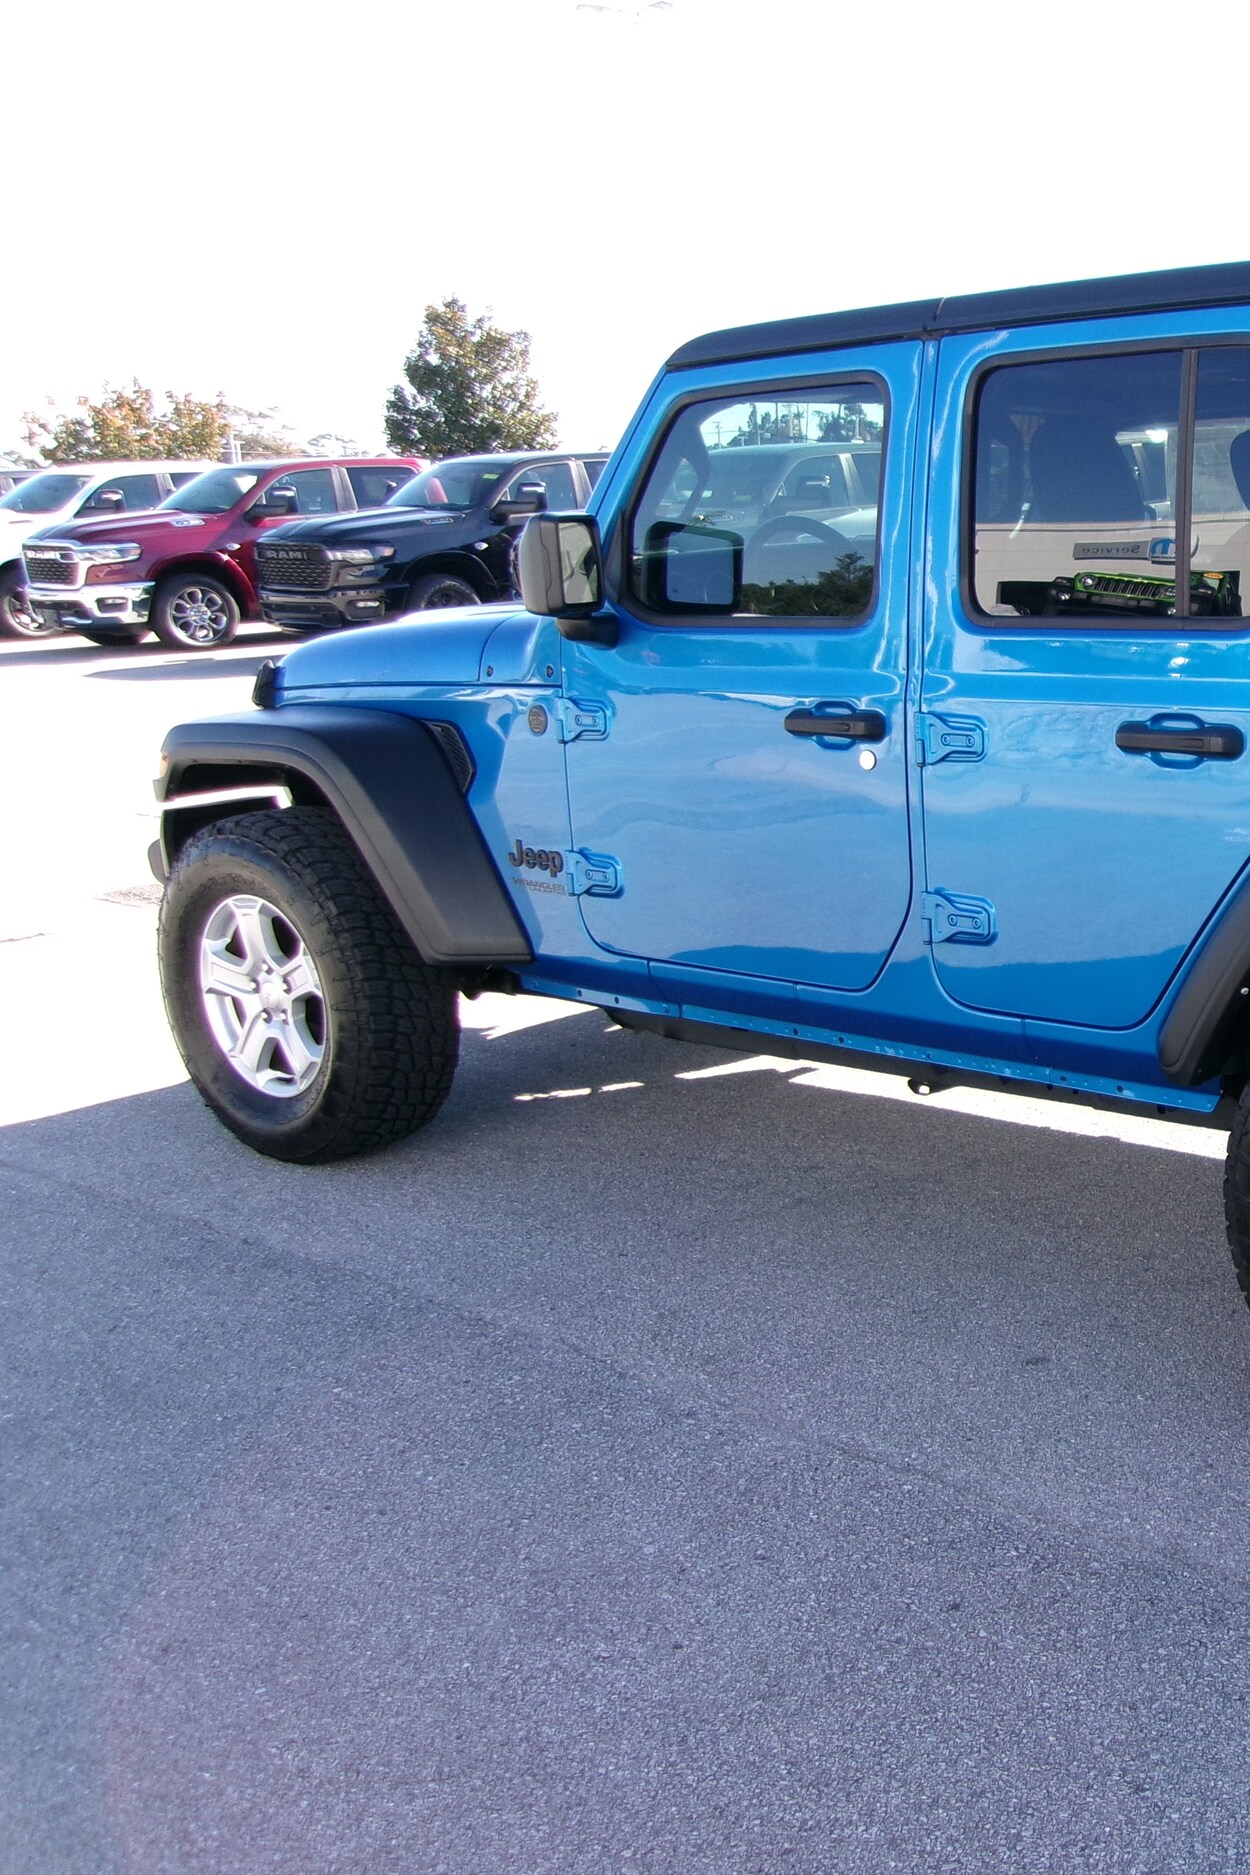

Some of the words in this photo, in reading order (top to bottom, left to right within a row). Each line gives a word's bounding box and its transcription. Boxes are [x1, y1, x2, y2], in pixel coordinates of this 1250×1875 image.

[26, 550, 56, 559] RAM
[267, 550, 303, 560] RAM
[508, 838, 564, 878] Jeep
[512, 876, 566, 893] WRANGLER
